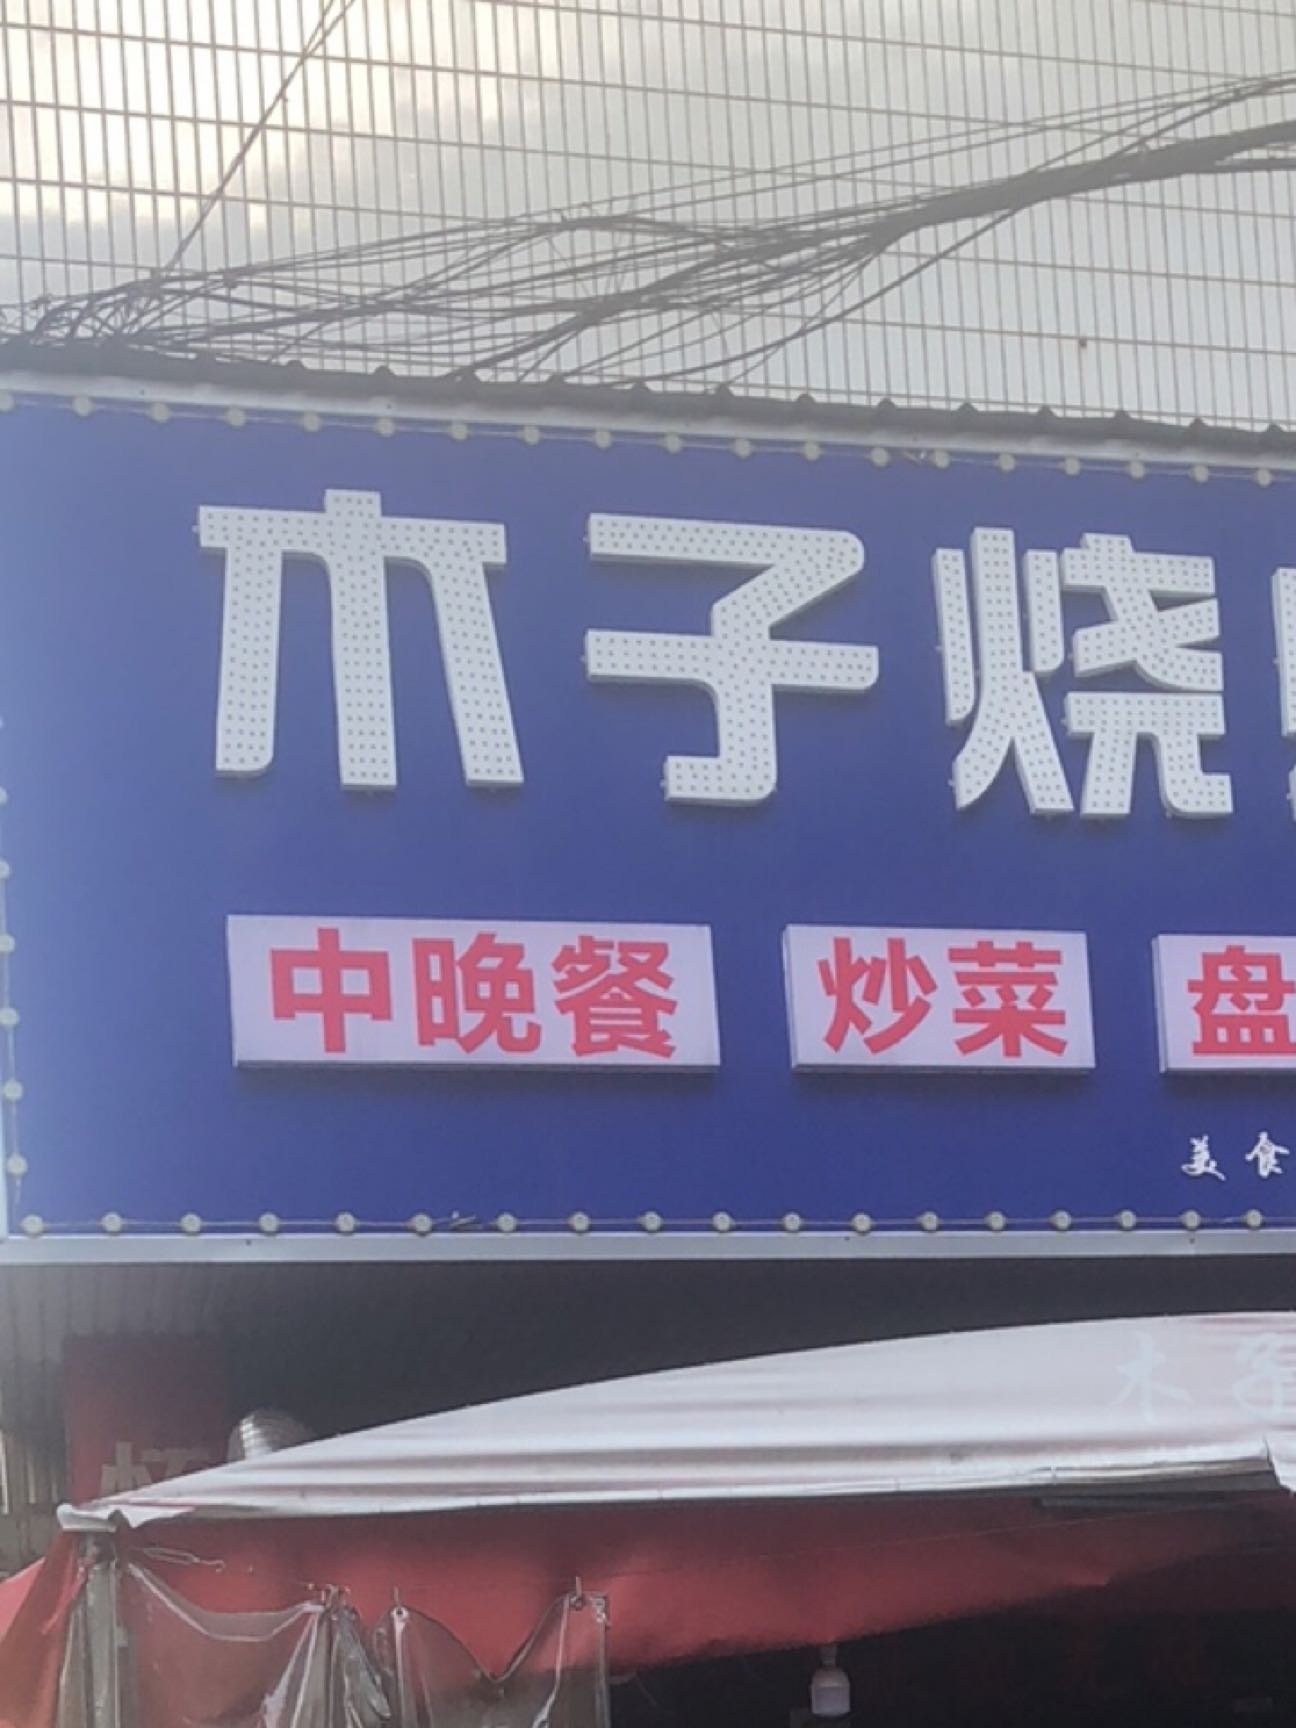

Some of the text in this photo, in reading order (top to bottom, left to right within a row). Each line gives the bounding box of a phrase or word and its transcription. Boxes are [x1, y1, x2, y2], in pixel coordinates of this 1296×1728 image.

[268, 928, 678, 1060] 中晚餐
[818, 936, 1070, 1058] 炒菜
